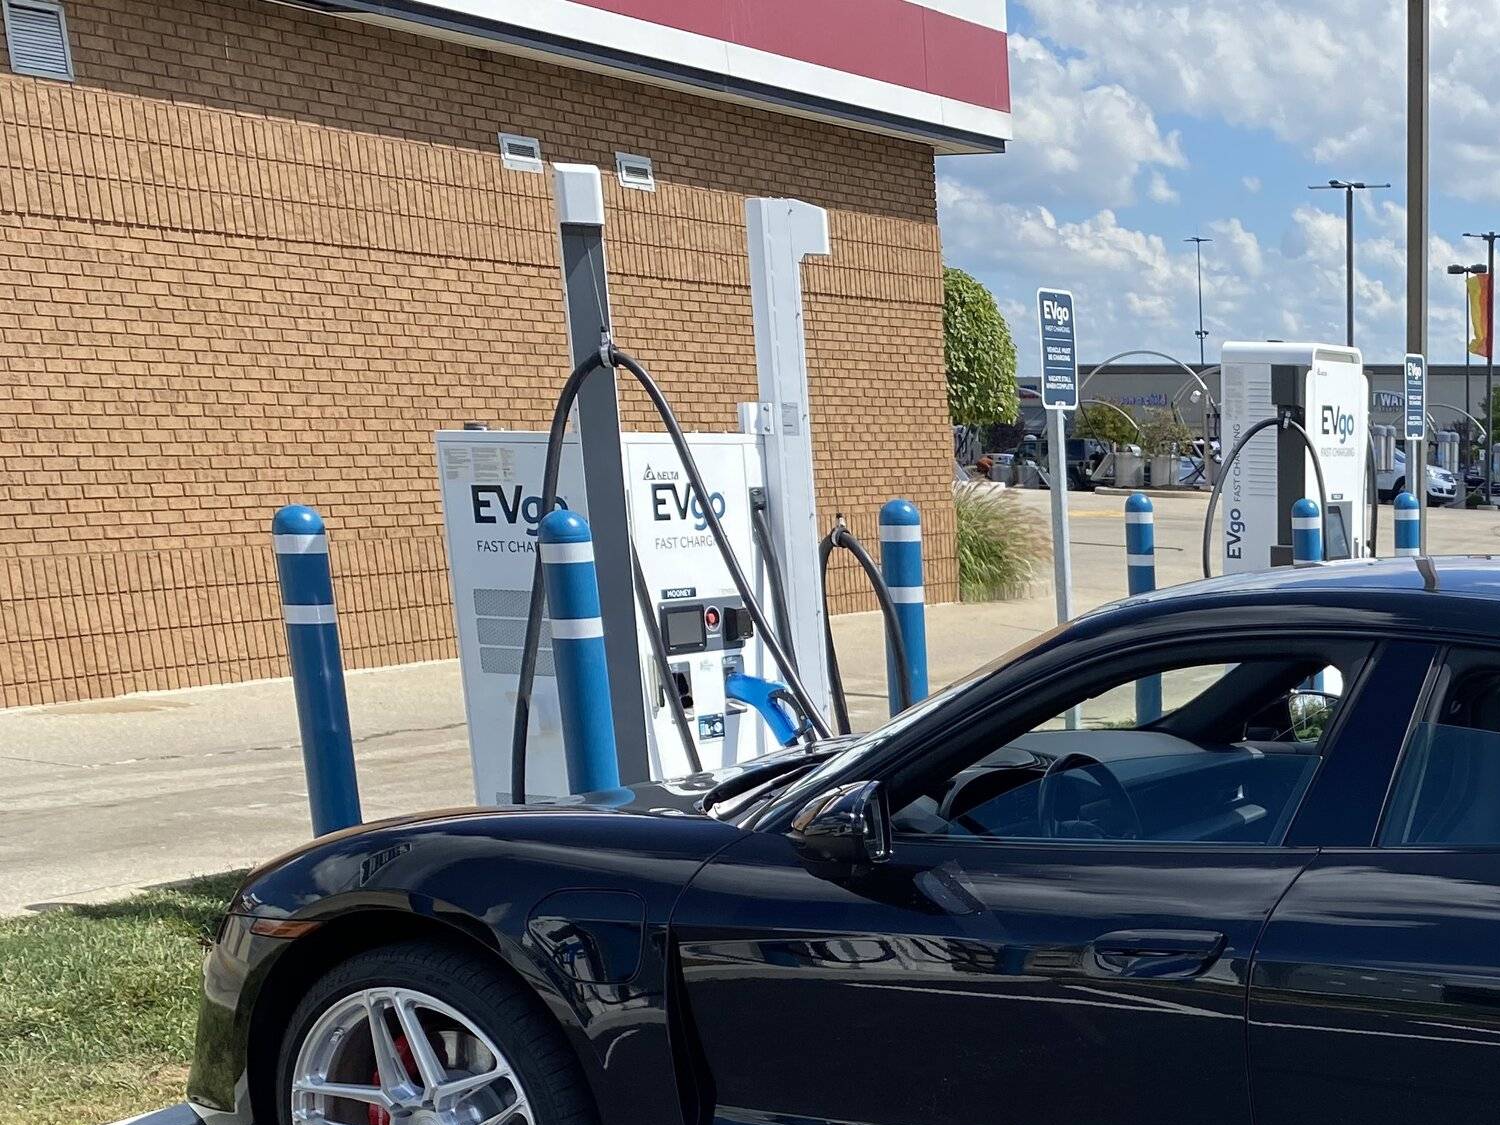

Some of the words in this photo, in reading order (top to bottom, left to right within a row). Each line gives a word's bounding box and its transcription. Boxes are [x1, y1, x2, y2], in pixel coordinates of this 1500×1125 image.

[1043, 300, 1069, 325] EVgo
[1321, 405, 1354, 444] EVgo
[651, 482, 726, 531] EVgo
[477, 540, 504, 553] FAST
[655, 537, 679, 550] FAST
[680, 535, 715, 549] CHARG
[1227, 508, 1246, 559] EVgo
